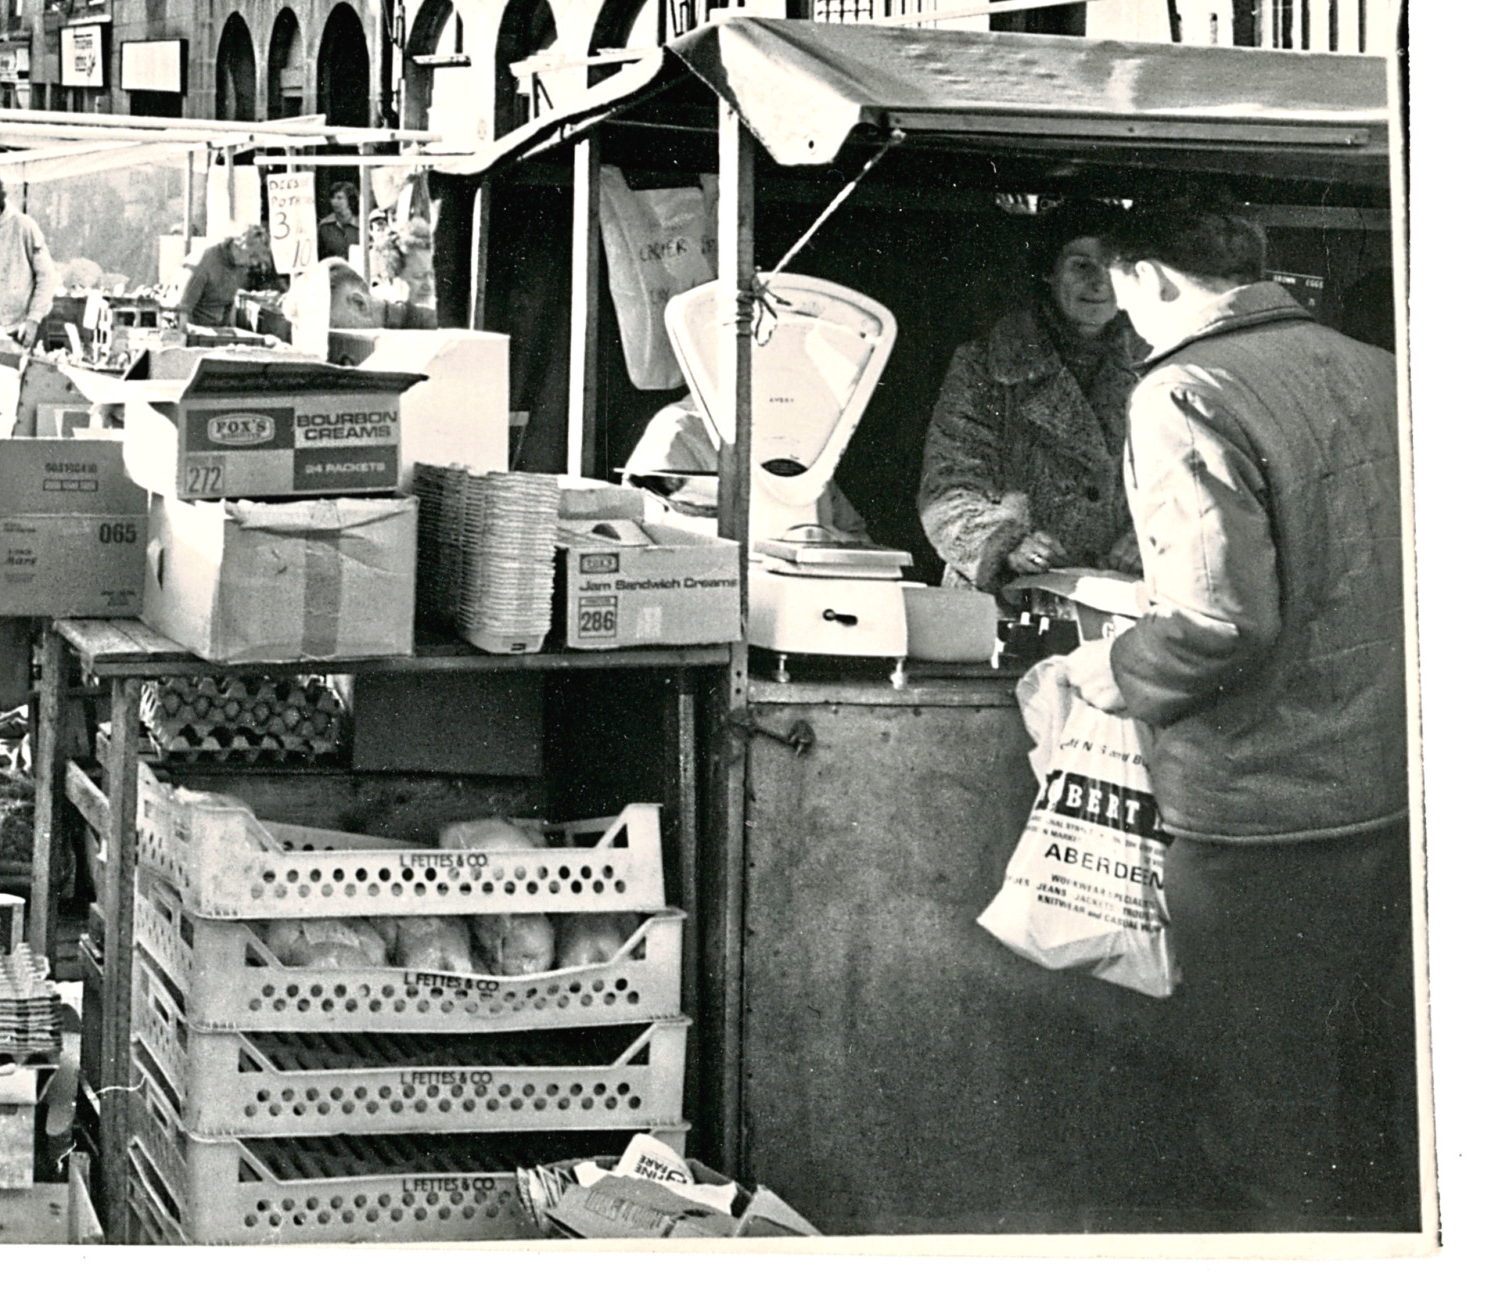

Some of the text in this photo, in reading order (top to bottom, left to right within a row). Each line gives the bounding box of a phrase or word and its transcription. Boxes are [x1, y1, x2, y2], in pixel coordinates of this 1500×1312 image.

[273, 211, 290, 240] 3
[215, 418, 267, 434] FOX'S
[296, 411, 398, 427] BOURBON
[304, 424, 392, 441] CREAMS
[326, 461, 386, 474] PACKETS
[189, 466, 221, 492] 272
[99, 522, 138, 544] 065
[579, 577, 738, 591] Jam Sandwich Creams
[580, 611, 615, 633] 286
[411, 854, 454, 868] FETTES
[1044, 842, 1164, 891] ABERDEEN
[1036, 883, 1067, 898] JEANS
[416, 973, 462, 989] FETTES
[412, 1071, 456, 1085] FETTES
[414, 1178, 459, 1193] FETTES
